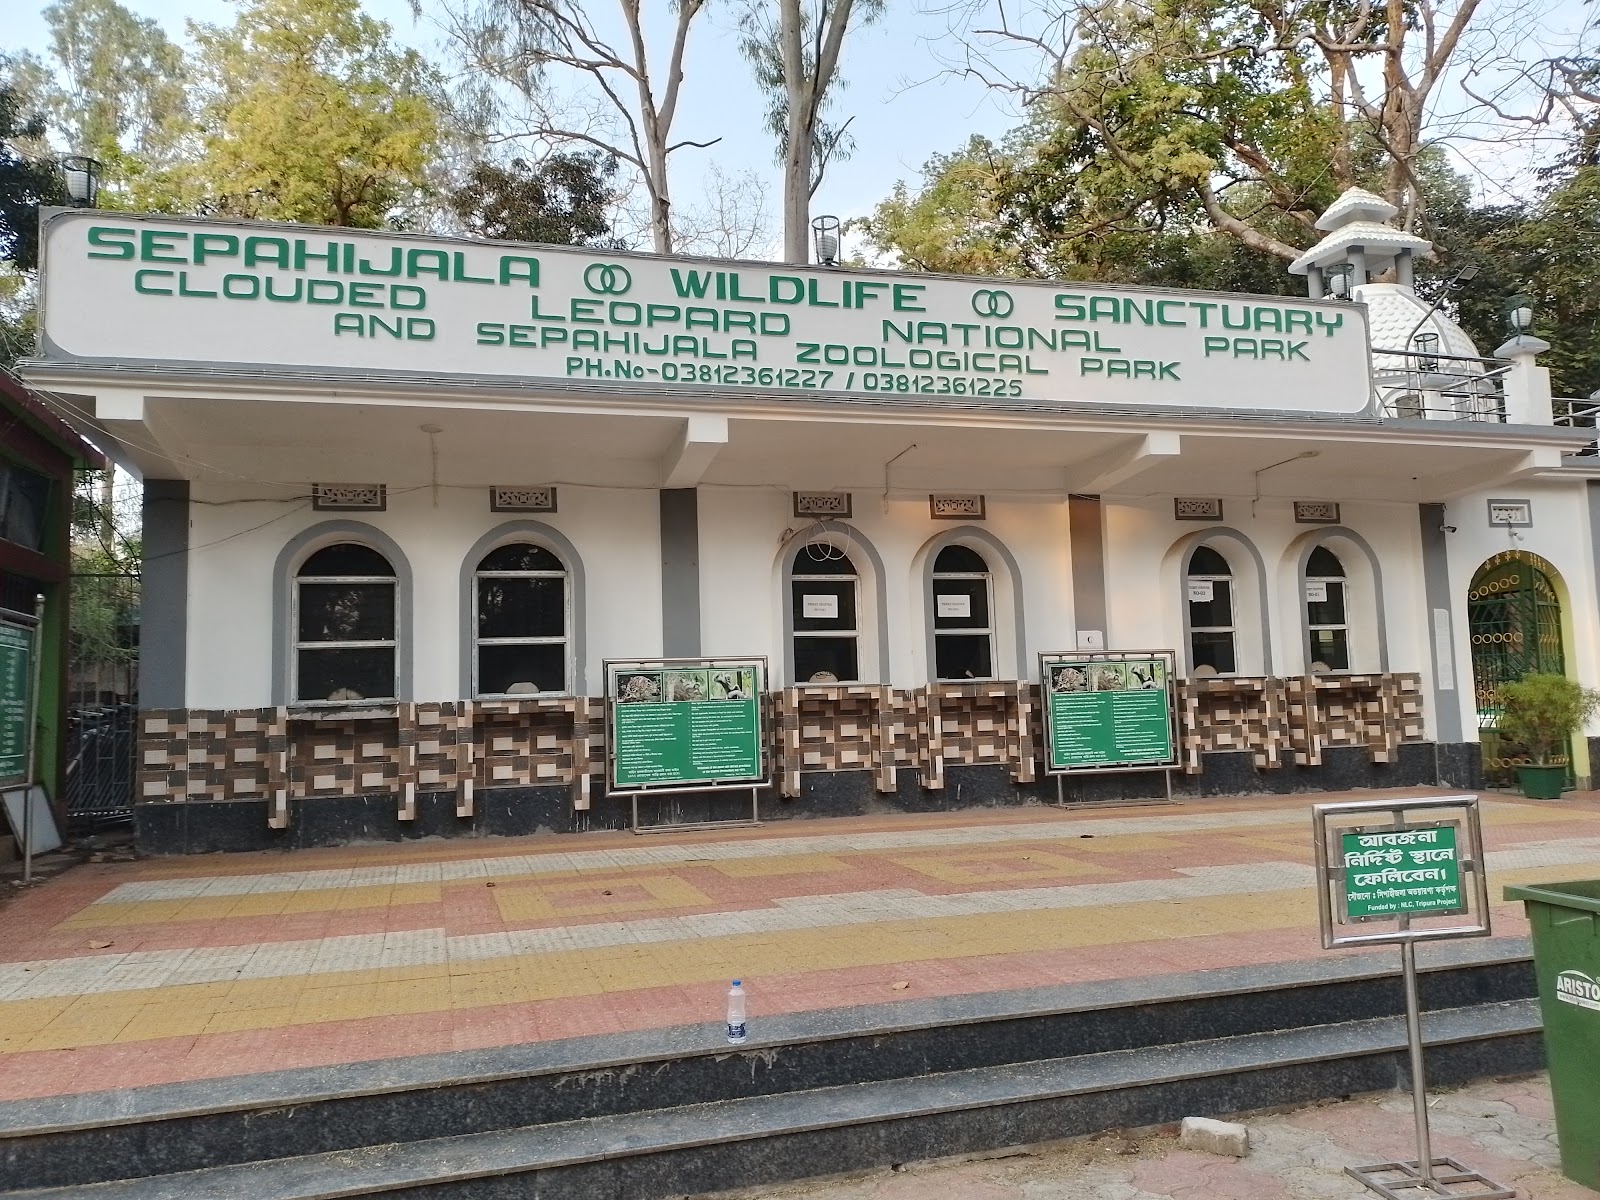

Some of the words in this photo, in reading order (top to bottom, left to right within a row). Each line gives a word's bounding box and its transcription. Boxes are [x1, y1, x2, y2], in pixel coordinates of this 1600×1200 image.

[87, 226, 540, 288] SEPAHIJALA
[671, 268, 926, 311] WILDLIFE
[1055, 294, 1344, 337] SANCTUARY
[134, 268, 427, 311] CLOUDED
[532, 297, 790, 337] LEOPARD
[882, 319, 1121, 353] NATIONAL
[1204, 335, 1311, 362] PARK
[334, 312, 436, 341] AND
[477, 322, 759, 361] SEPAHIJALA
[796, 342, 1049, 375] ZOOLOGICAL
[1080, 357, 1182, 381] PARK
[863, 372, 1023, 397] 03812361225
[1357, 830, 1438, 848] আবর্জনা
[1344, 848, 1404, 868] নির্দিষ্ট
[1408, 848, 1455, 865] স্থানে
[1367, 903, 1389, 911] Funded
[1389, 902, 1397, 911] by
[1415, 900, 1436, 908] Tripura
[1436, 898, 1457, 907] Project
[1556, 975, 1600, 1001] ARISTO
